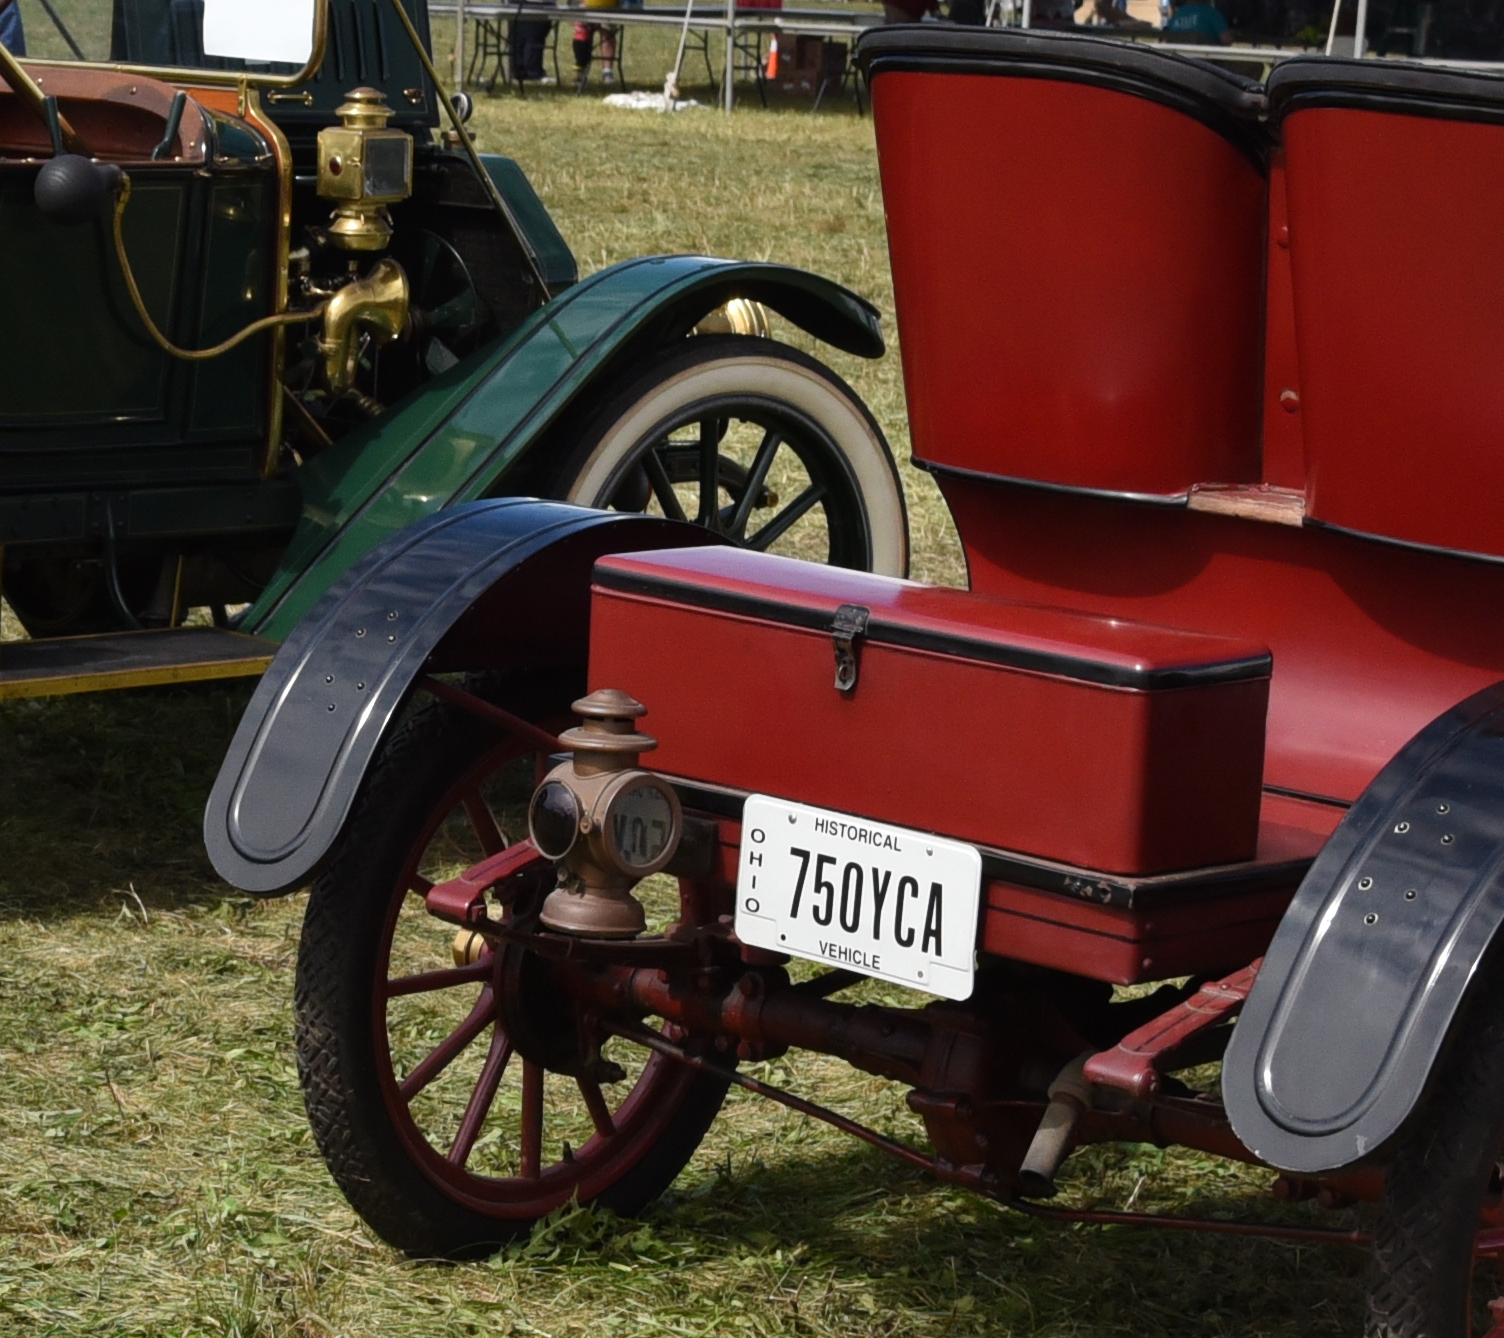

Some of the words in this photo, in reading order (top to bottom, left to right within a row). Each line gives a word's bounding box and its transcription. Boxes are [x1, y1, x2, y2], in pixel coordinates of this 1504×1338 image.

[814, 817, 902, 852] HISTORICAL
[745, 828, 766, 913] OHIO
[789, 847, 943, 957] 750YCA
[819, 940, 881, 970] VEHICLE
